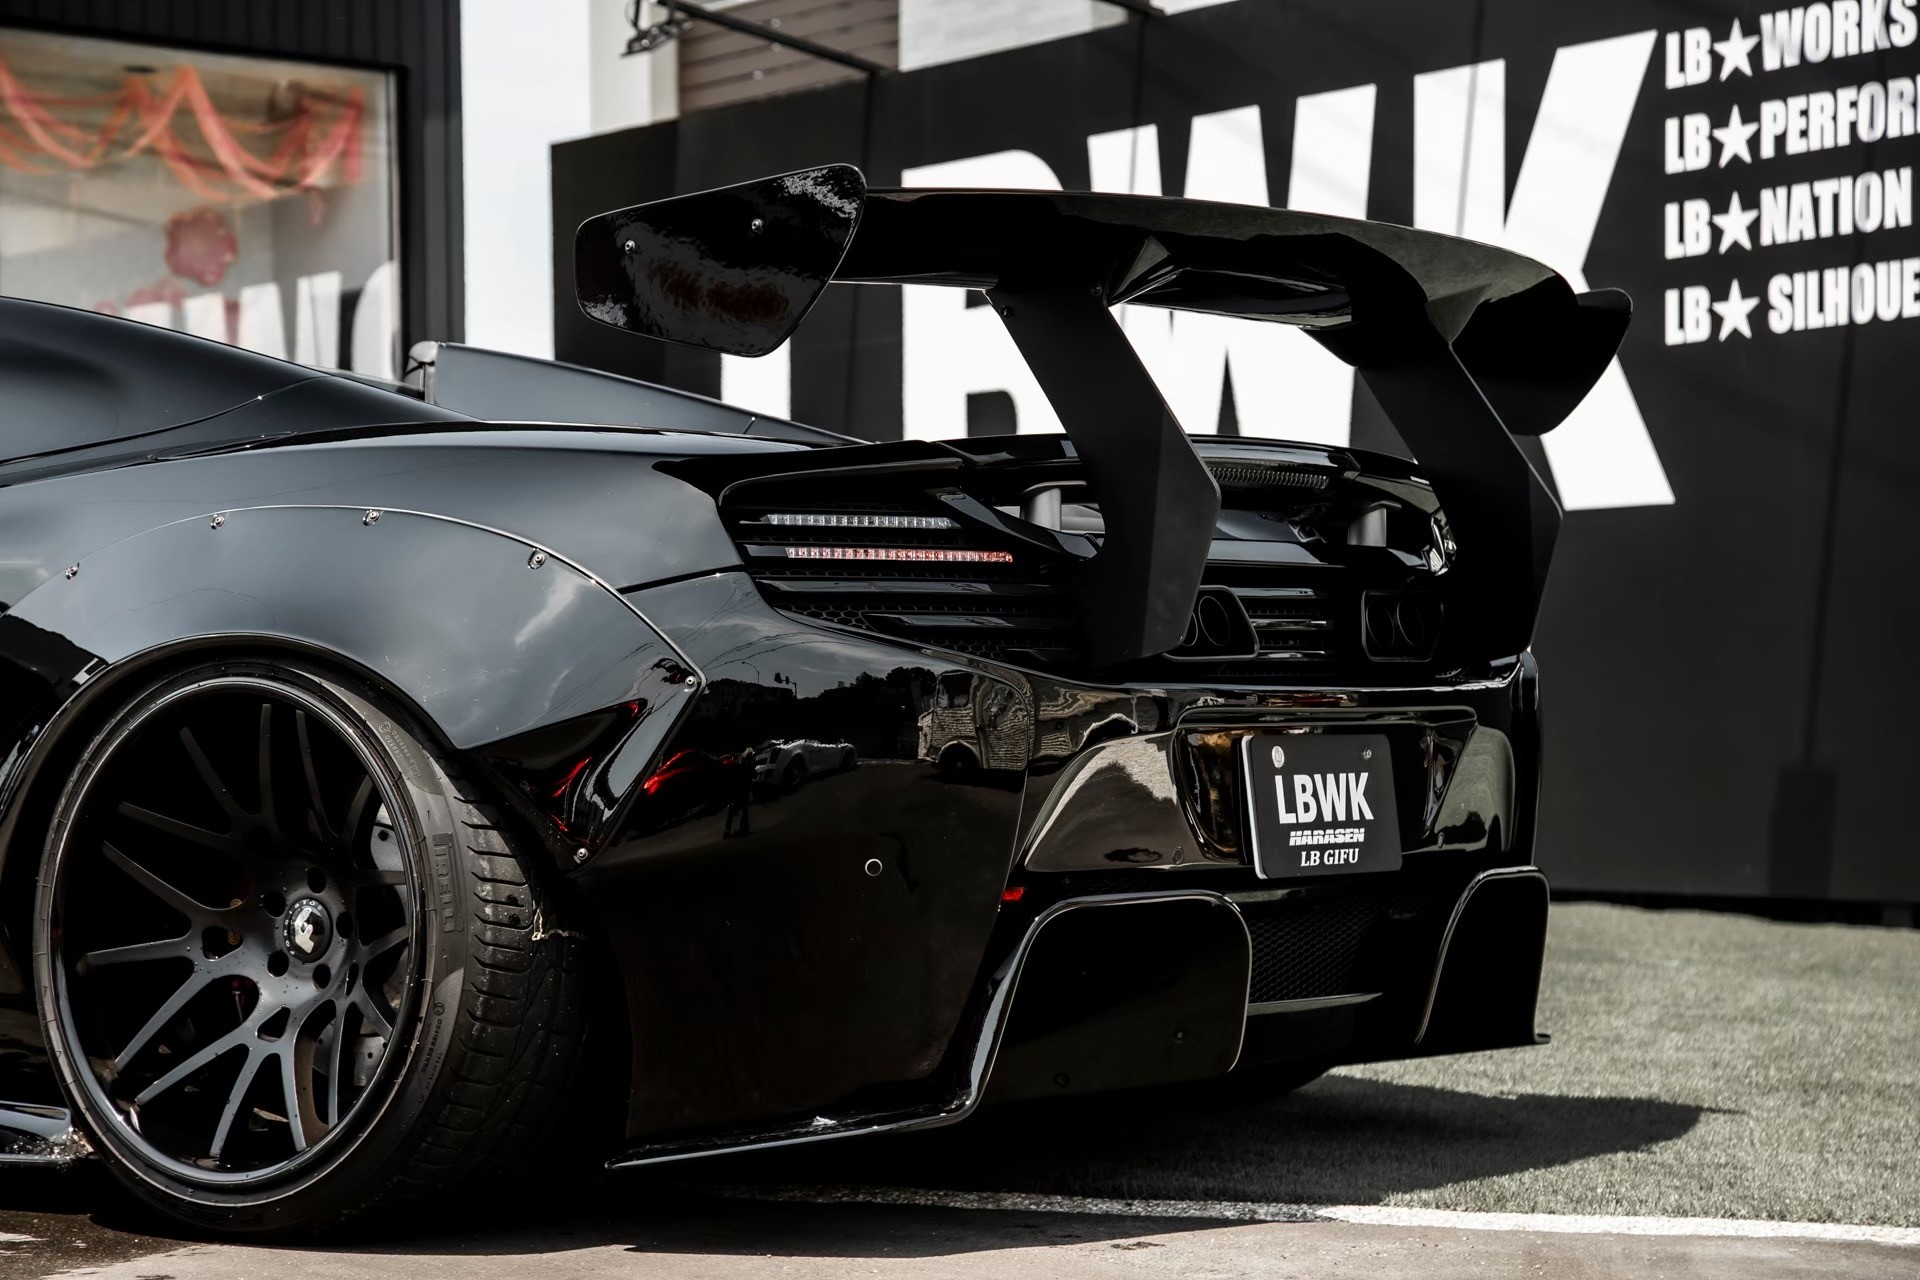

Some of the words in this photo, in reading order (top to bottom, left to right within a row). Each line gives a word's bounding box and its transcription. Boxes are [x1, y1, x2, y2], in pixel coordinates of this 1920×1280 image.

[1665, 27, 1712, 89] LB
[1760, 0, 1918, 71] WORKS
[1665, 113, 1712, 174] LB
[1760, 74, 1920, 159] PERFOR
[1665, 199, 1712, 260] LB
[1760, 166, 1912, 247] NATION
[1665, 285, 1712, 346] LB
[1274, 772, 1374, 824] LBWK
[1289, 828, 1365, 846] HARASEN
[1300, 851, 1320, 866] LB
[1324, 848, 1359, 865] GIFU
